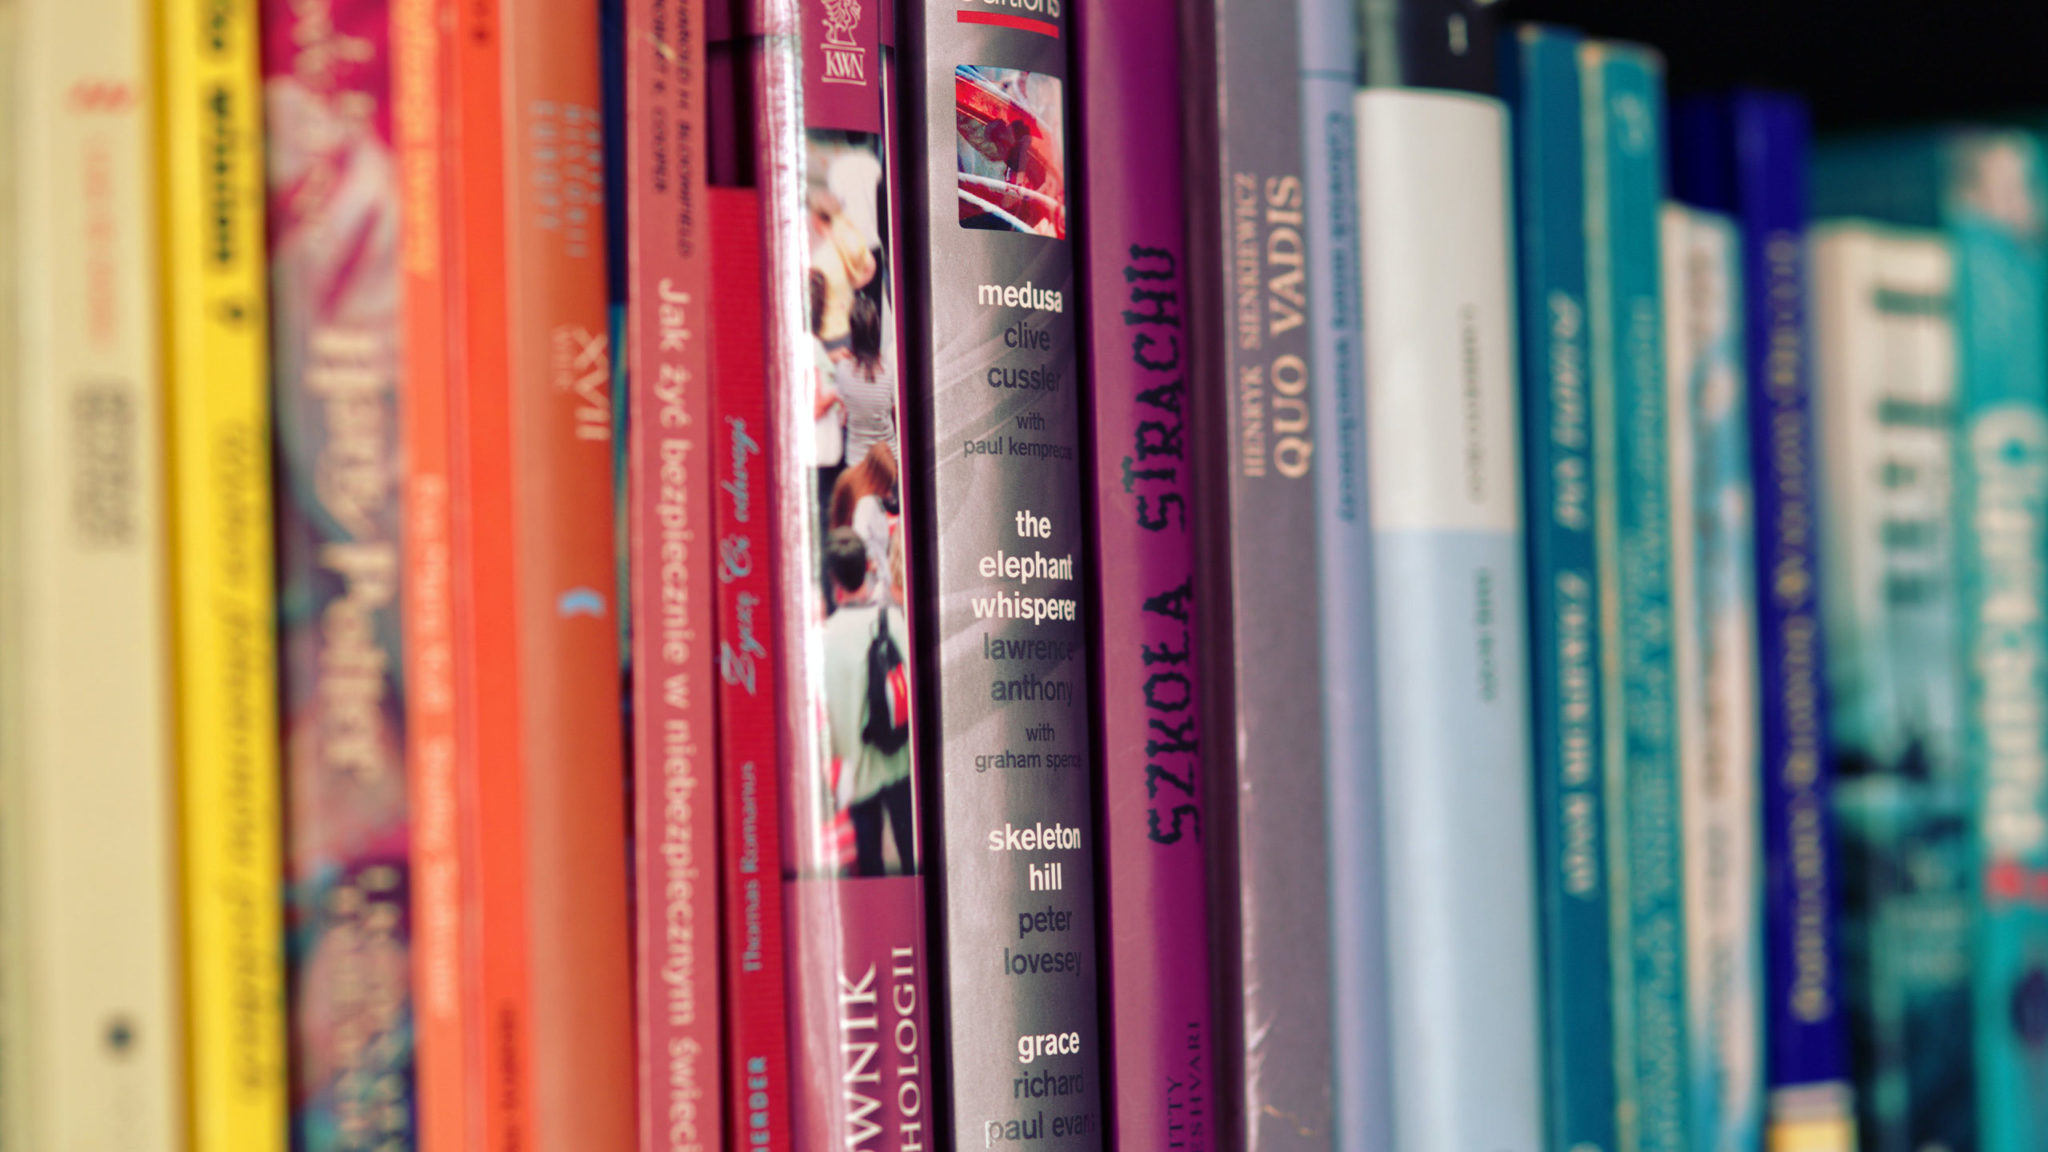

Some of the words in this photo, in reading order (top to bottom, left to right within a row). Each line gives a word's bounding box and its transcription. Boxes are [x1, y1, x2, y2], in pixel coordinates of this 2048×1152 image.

[825, 50, 864, 80] KWN
[1233, 171, 1263, 351] SIENKIEWICZ
[1264, 174, 1306, 337] VADIS
[658, 278, 692, 351] Jak
[978, 281, 1063, 313] medusa
[1004, 322, 1051, 351] clive
[574, 326, 610, 440] XVII
[652, 363, 692, 428] żyć
[987, 364, 1062, 392] cussler
[1120, 243, 1184, 533] STRACHU
[1016, 412, 1045, 431] with
[1239, 364, 1266, 478] HENRYK
[1270, 353, 1314, 480] QUO
[964, 437, 1003, 457] paul
[721, 416, 759, 522] odwagi
[1015, 510, 1051, 539] the
[656, 438, 695, 664] bezpiecznie
[718, 534, 753, 583] Ci
[979, 550, 1073, 585] elephant
[972, 591, 1076, 626] whisperer
[714, 592, 767, 695] Życzę
[983, 632, 1073, 661] lawrence
[320, 543, 396, 782] Potter
[663, 673, 691, 709] w
[991, 674, 1073, 706] anthony
[1141, 575, 1200, 845] SZKOŁA
[1025, 723, 1055, 742] with
[975, 749, 1040, 774] graham
[739, 761, 758, 874] Romanus
[988, 822, 1081, 852] skeleton
[660, 719, 699, 1025] niebezpiecznym
[1029, 862, 1062, 891] hill
[741, 879, 762, 972] Thomas
[1019, 906, 1072, 939] peter
[1003, 946, 1082, 977] lovesey
[837, 961, 883, 1152] WNIK
[1018, 1031, 1080, 1063] grace
[1013, 1069, 1084, 1098] richard
[985, 1110, 1043, 1150] paul
